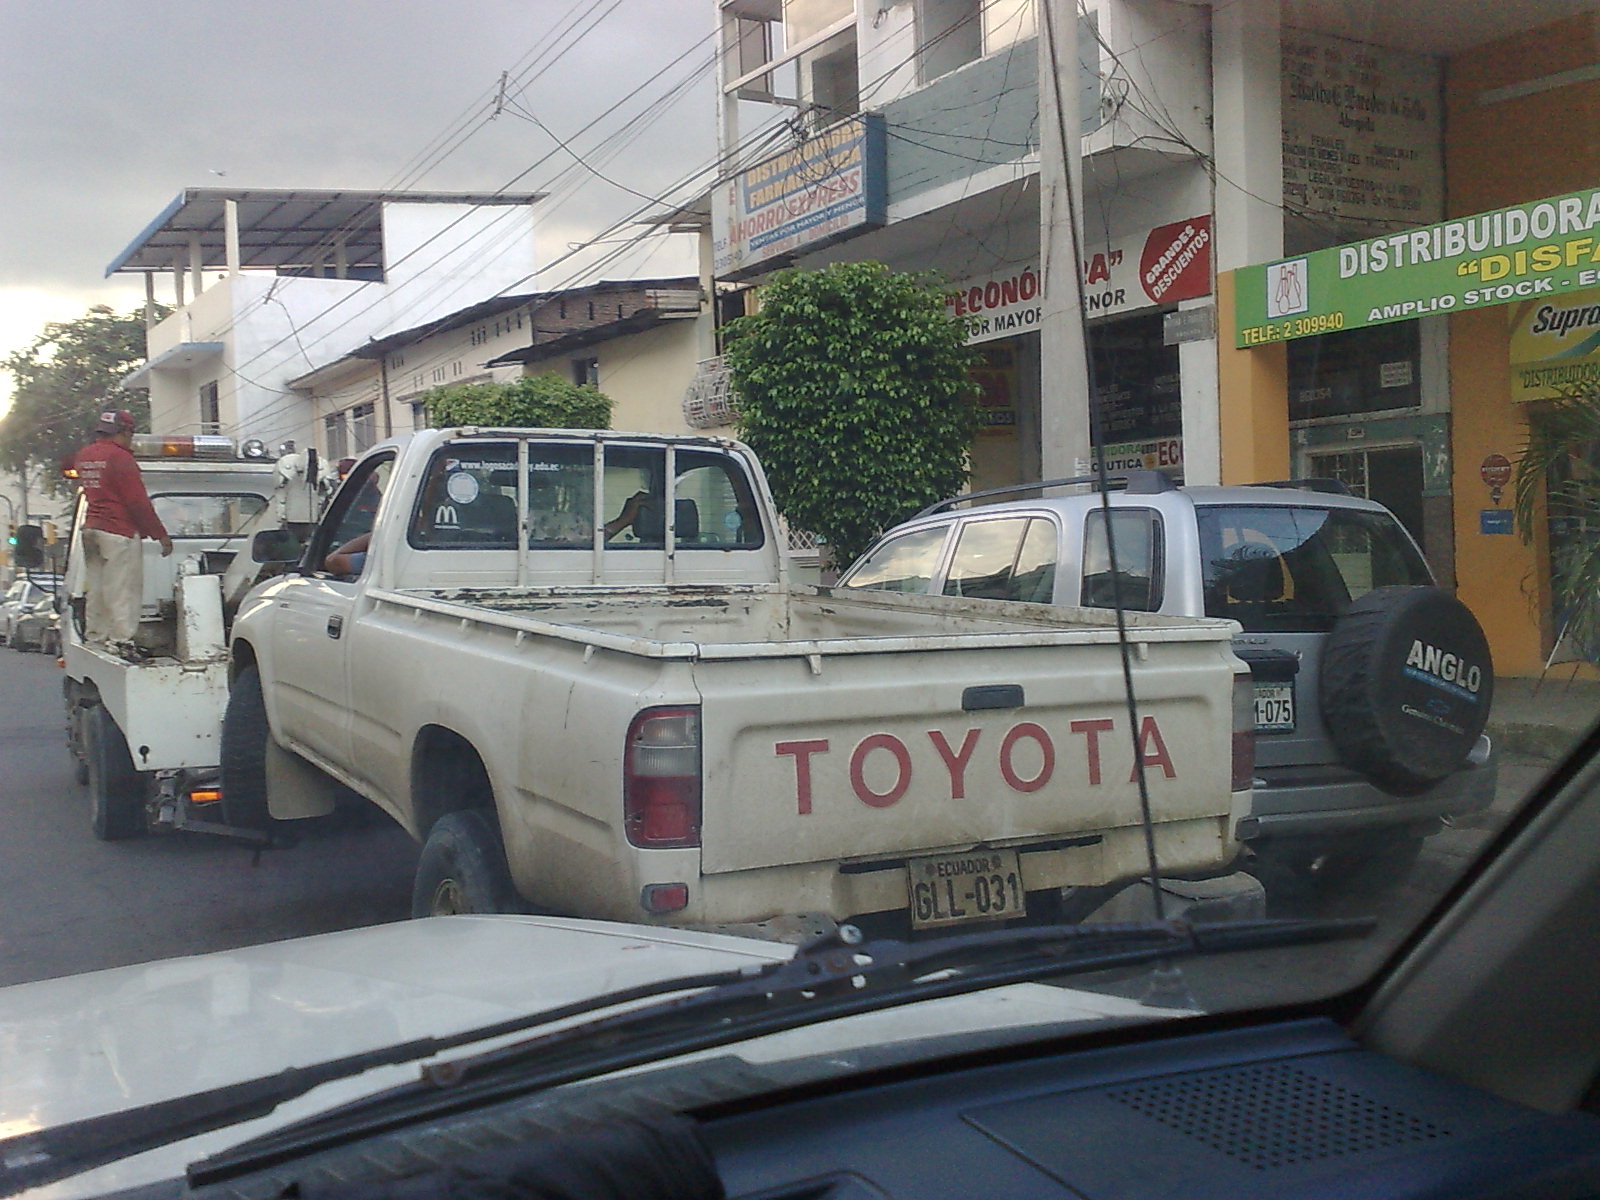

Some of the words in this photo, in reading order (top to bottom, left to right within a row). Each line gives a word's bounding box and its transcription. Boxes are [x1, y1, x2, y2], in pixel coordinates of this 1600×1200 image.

[785, 169, 861, 219] EXPRESS
[1146, 225, 1195, 284] GRANDES
[1152, 229, 1209, 298] DESCUENTOS
[1367, 294, 1456, 321] AMPLIO
[1463, 277, 1553, 305] STOCK
[1283, 321, 1292, 338] 2
[1295, 312, 1344, 336] 309940
[1405, 639, 1481, 693] ANGLO
[774, 714, 1178, 815] TOYOTA
[937, 858, 991, 877] ECUADOR
[914, 872, 1020, 921] GLL-031
